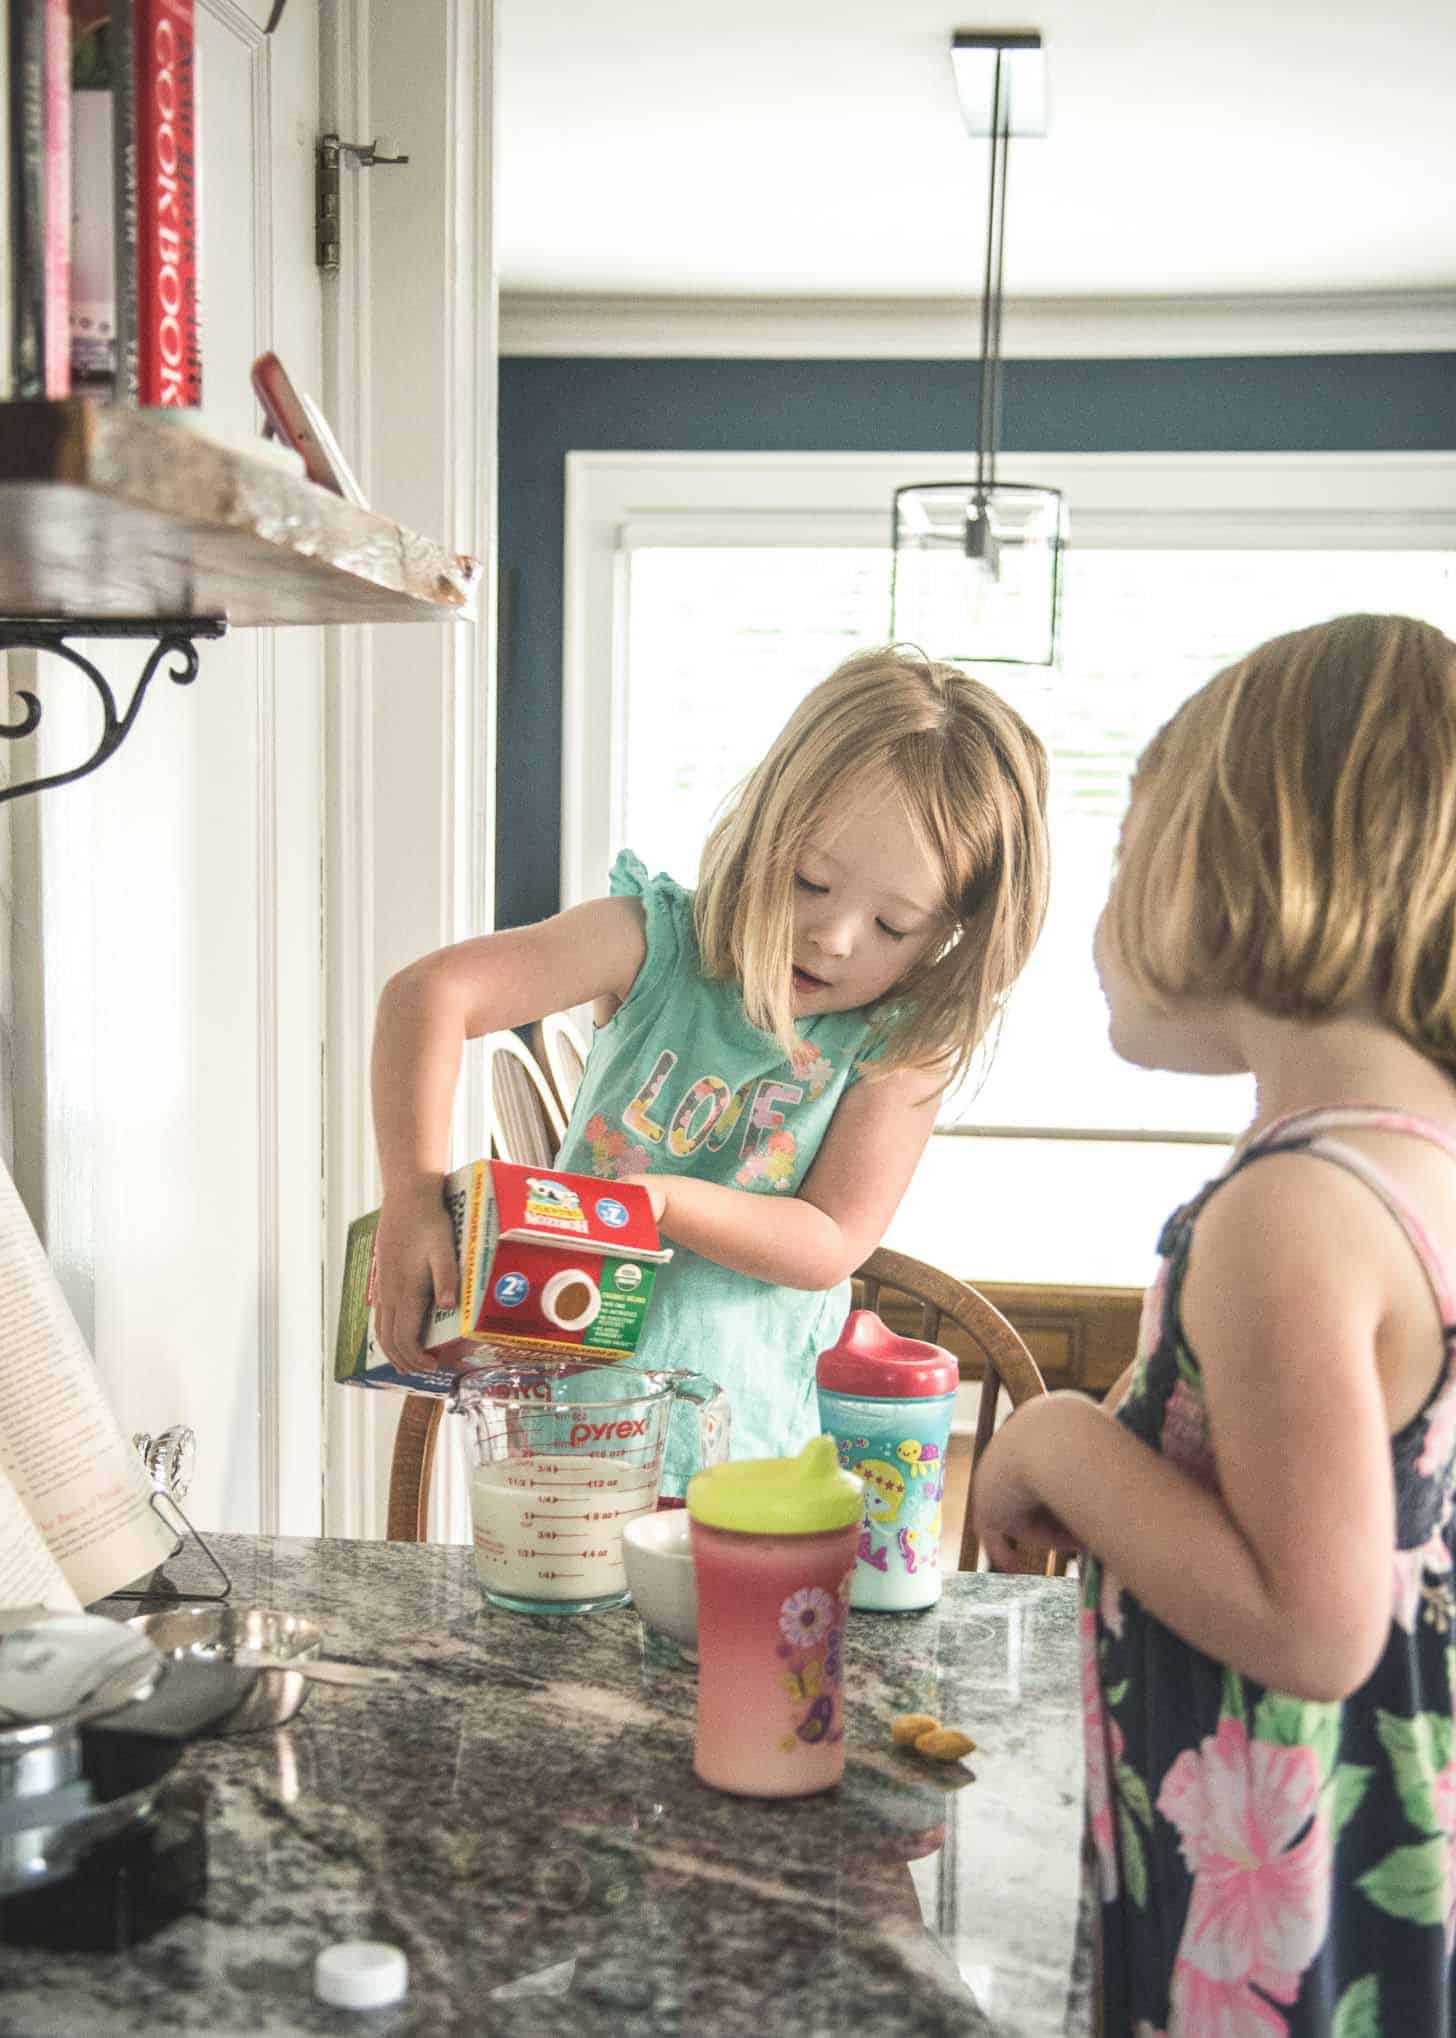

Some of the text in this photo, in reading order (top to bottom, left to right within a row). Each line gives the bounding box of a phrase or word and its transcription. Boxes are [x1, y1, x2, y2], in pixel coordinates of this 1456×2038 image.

[155, 19, 183, 407] COOK BOOK
[569, 1418, 645, 1448] pyrex
